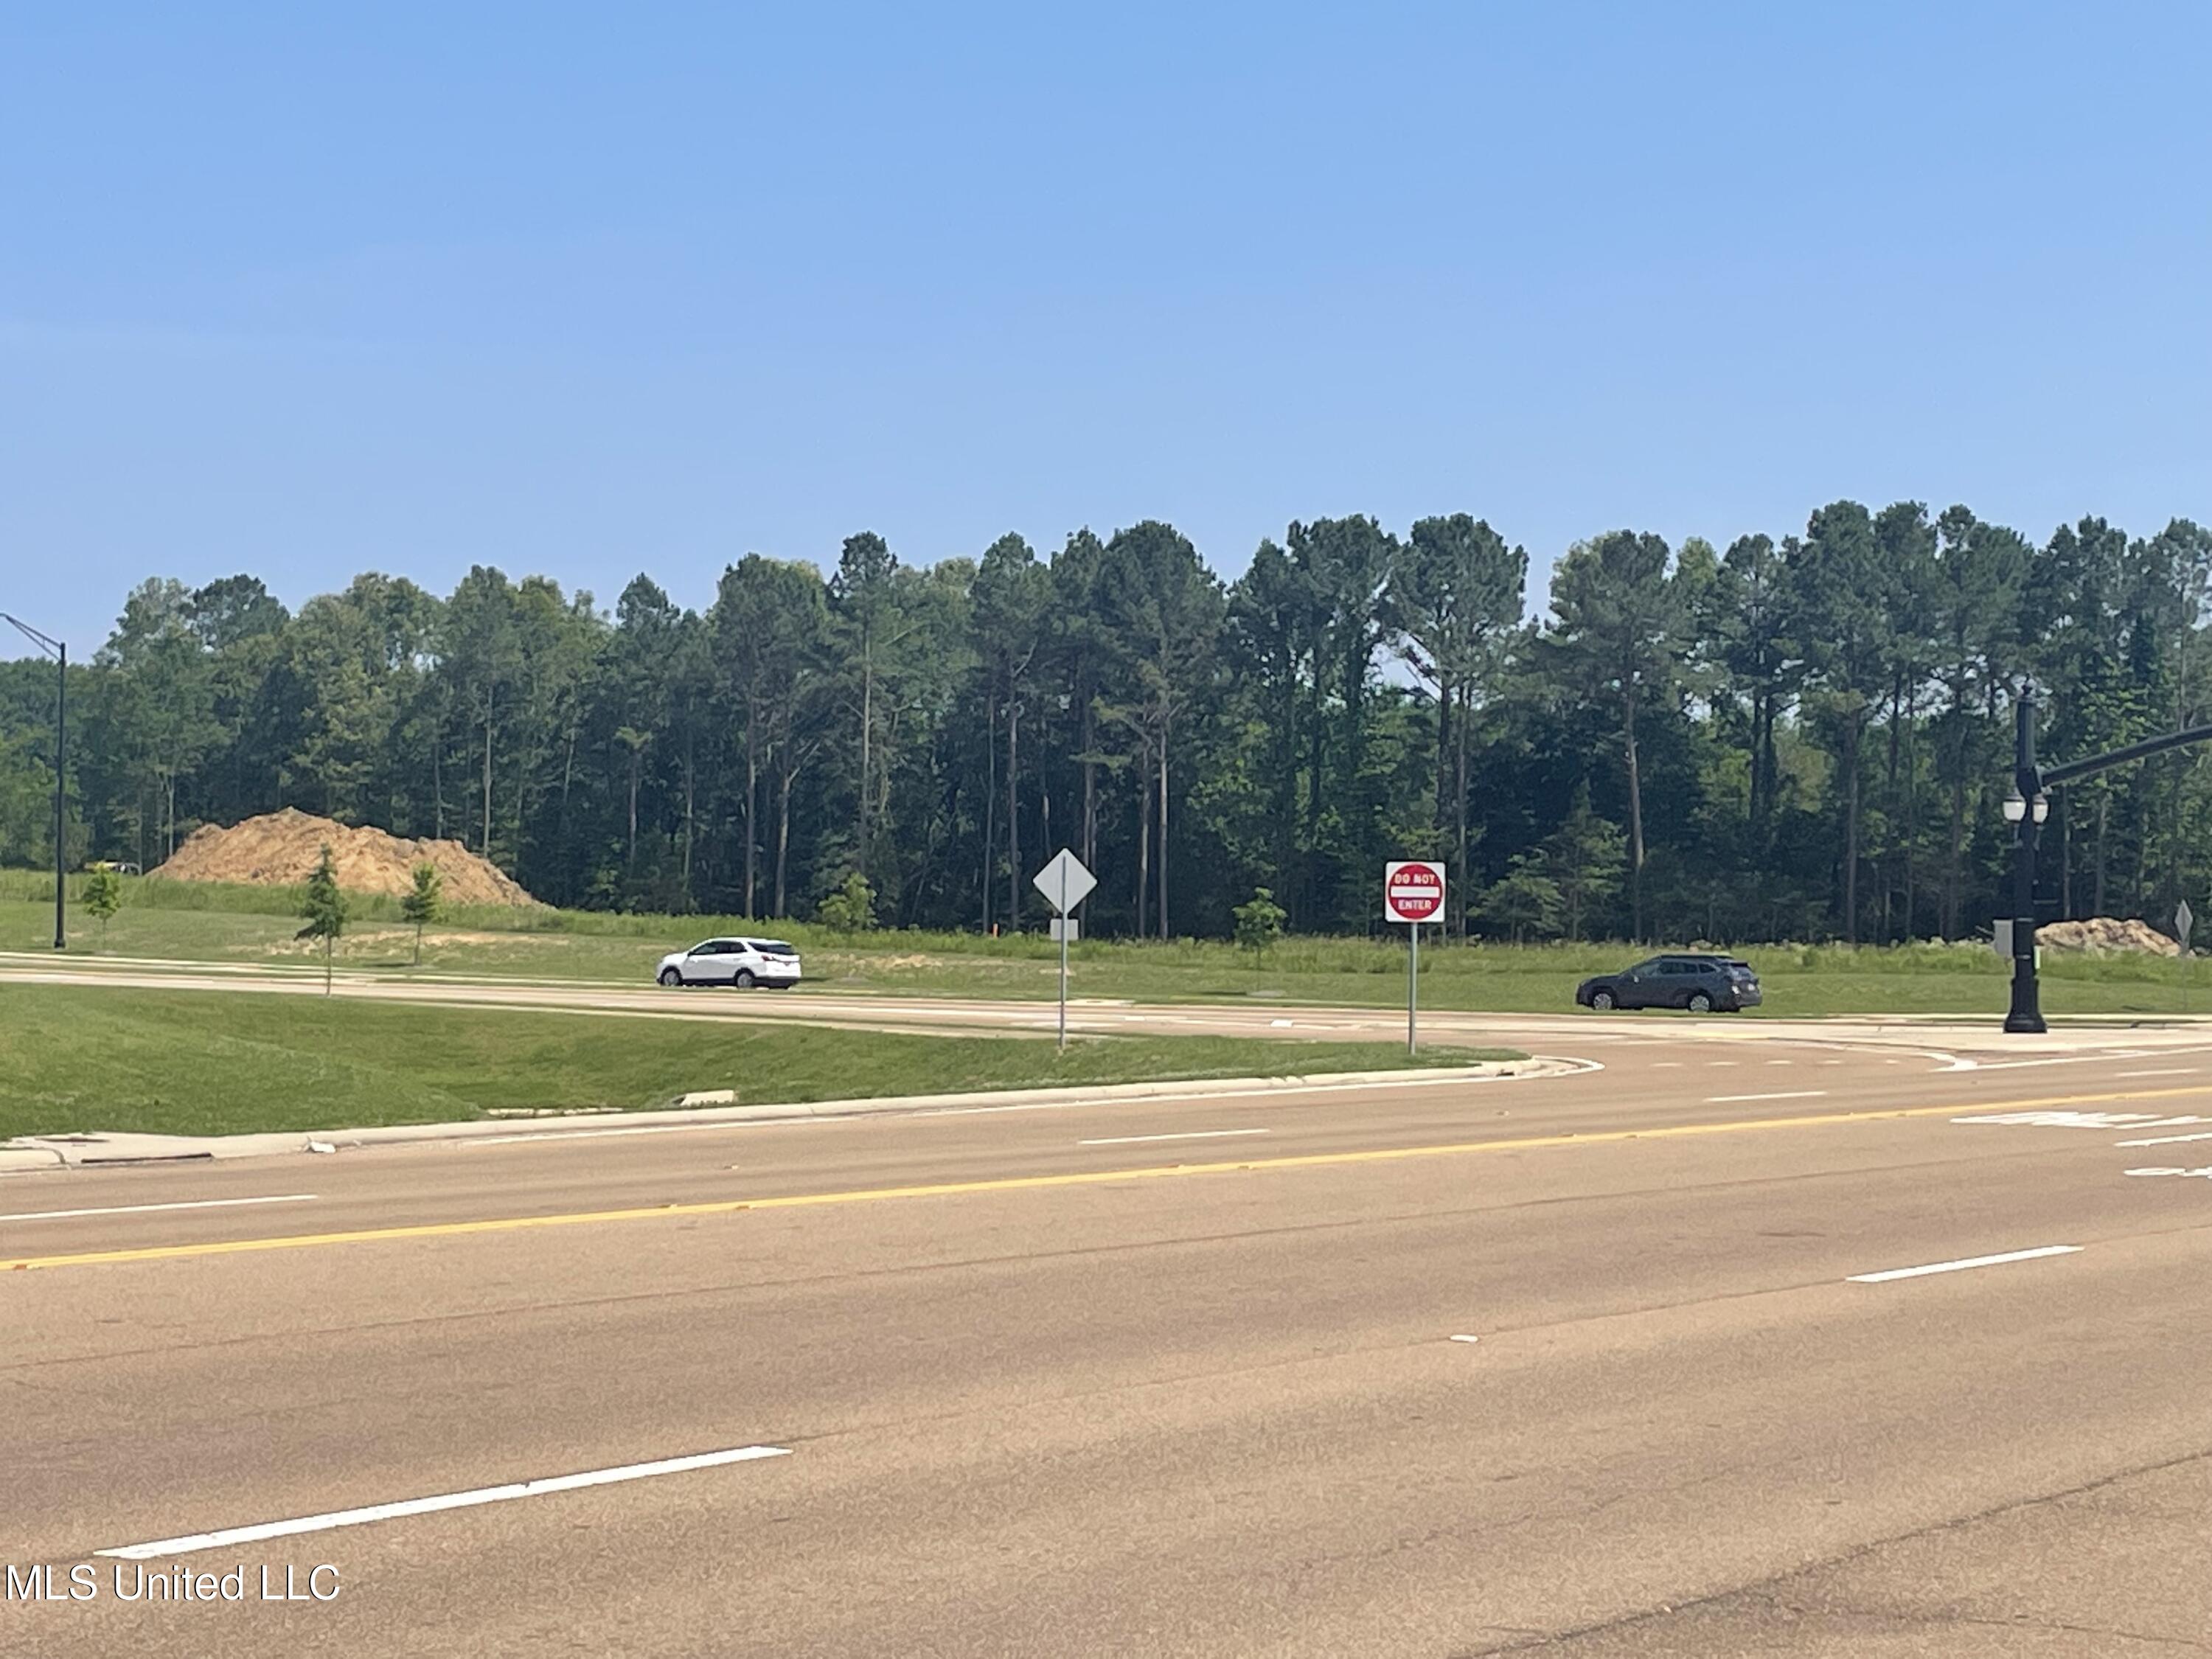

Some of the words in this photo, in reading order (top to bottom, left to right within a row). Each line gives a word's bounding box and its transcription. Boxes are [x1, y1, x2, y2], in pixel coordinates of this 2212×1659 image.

[1394, 873, 1410, 884] DO
[1413, 873, 1435, 884] NOT
[1398, 900, 1432, 910] ENTER
